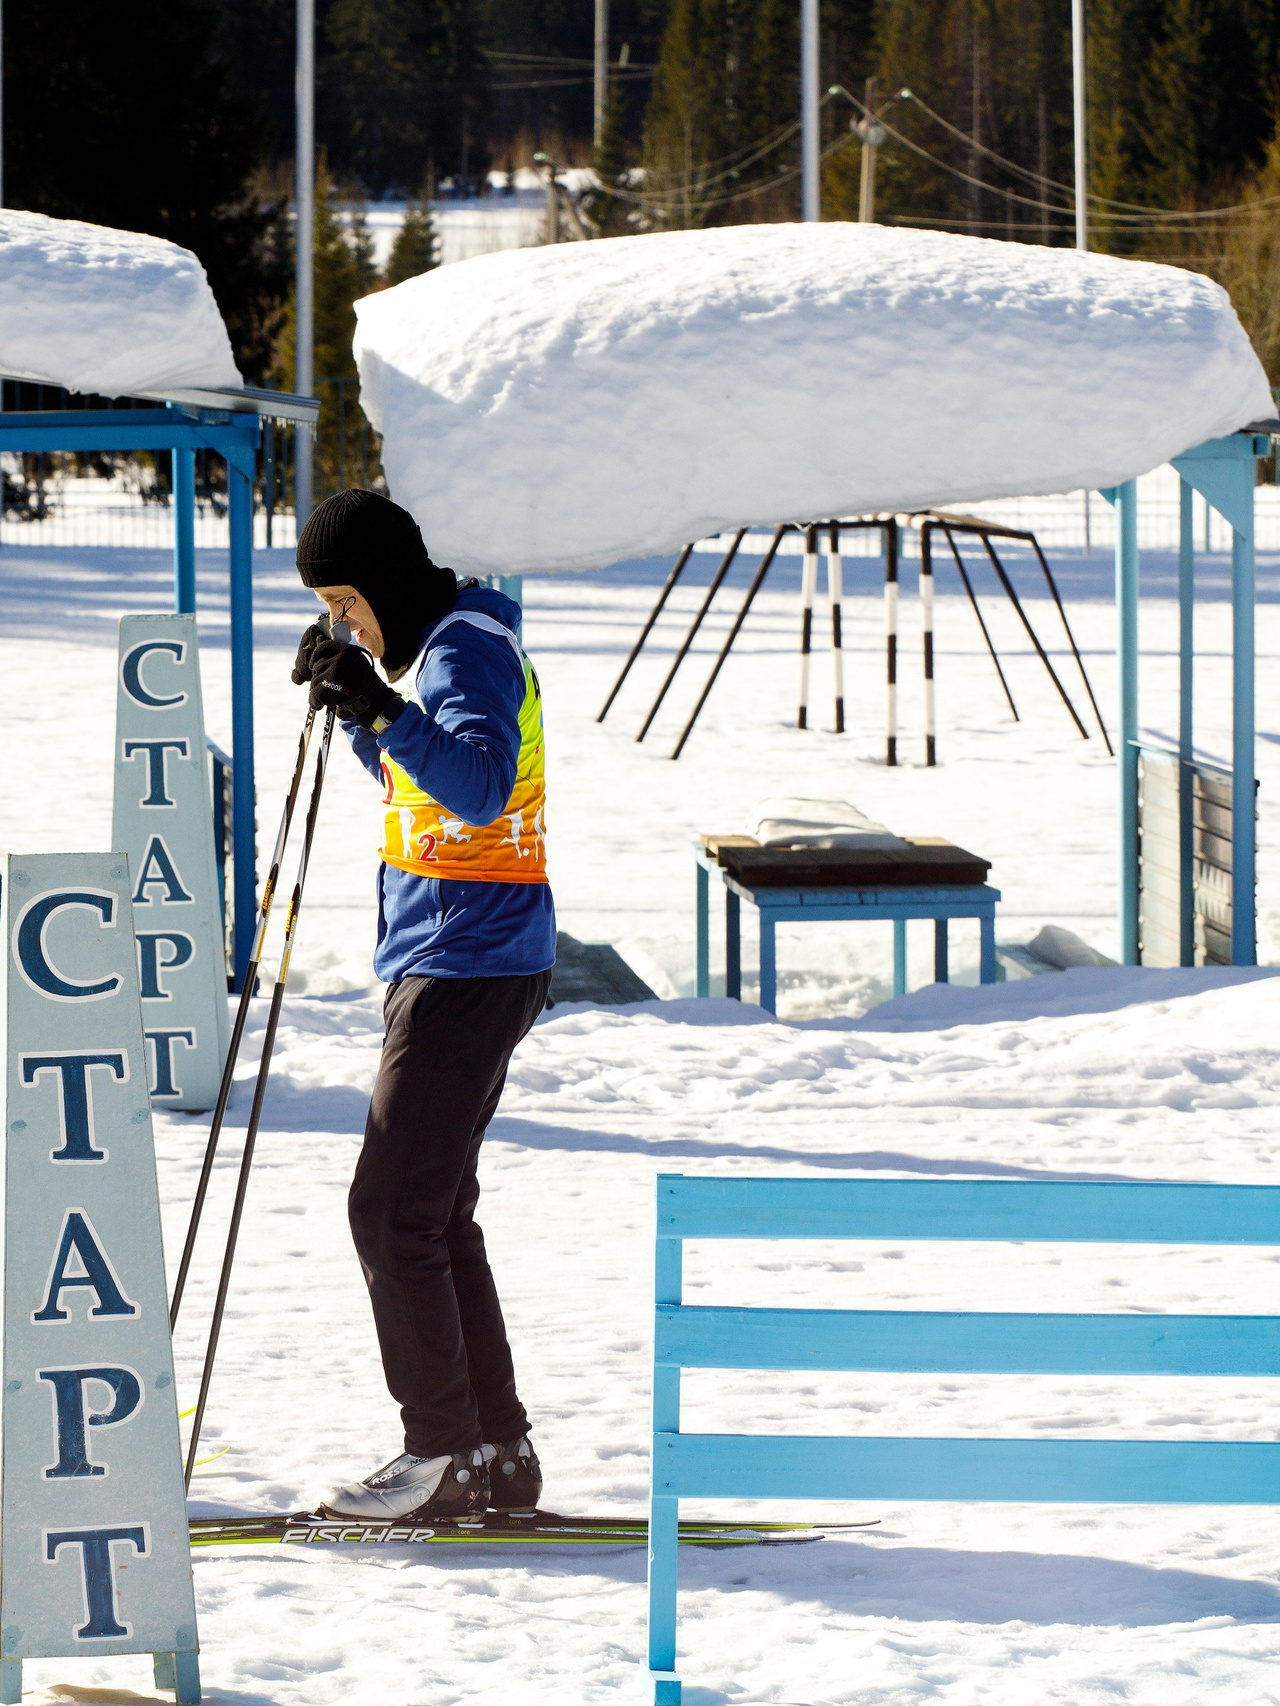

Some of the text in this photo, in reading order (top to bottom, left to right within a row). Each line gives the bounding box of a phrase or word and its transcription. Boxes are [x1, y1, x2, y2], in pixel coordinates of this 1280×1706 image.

[120, 639, 198, 1099] СТАРТ
[417, 832, 438, 862] 2
[12, 887, 146, 1642] СТАРТ
[280, 1527, 436, 1543] FISCHER
